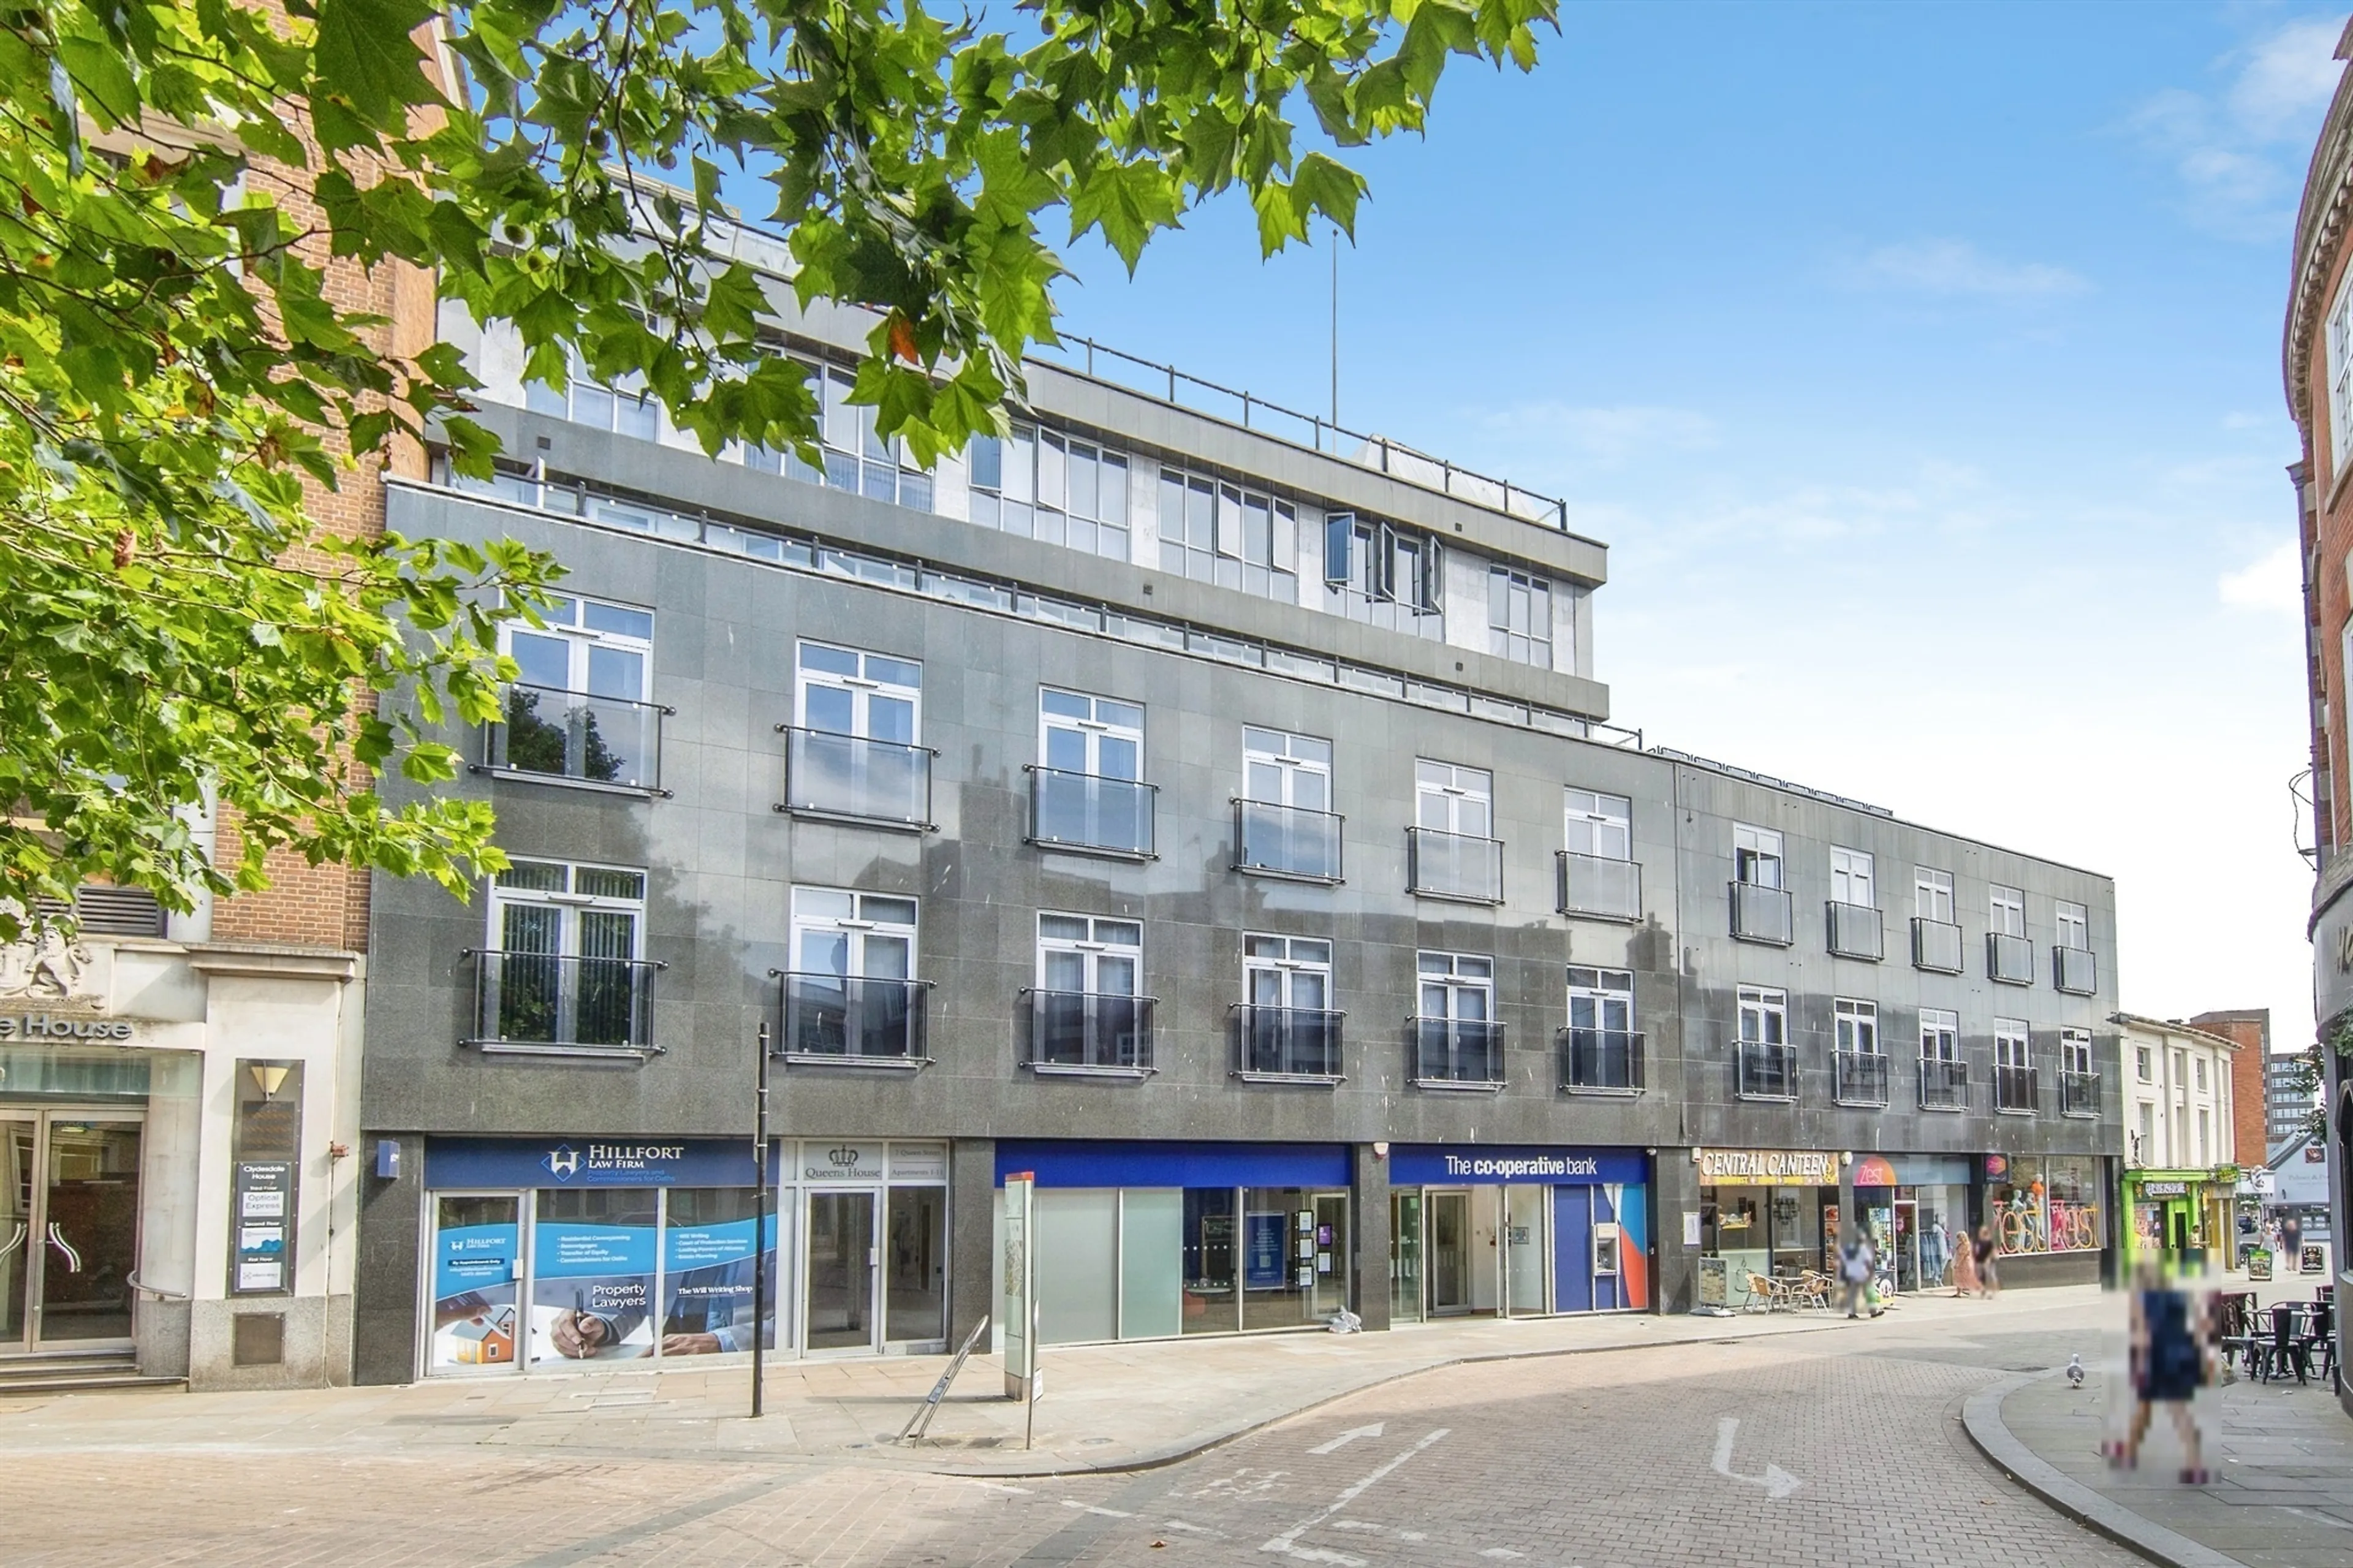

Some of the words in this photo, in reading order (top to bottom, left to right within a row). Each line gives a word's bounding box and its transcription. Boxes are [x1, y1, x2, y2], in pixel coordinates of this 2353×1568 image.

[24, 1013, 132, 1039] House
[589, 1145, 684, 1159] HILLFORT
[588, 1159, 613, 1168] LAW
[616, 1159, 644, 1168] FIRM
[1445, 1156, 1471, 1175] The
[1474, 1156, 1564, 1179] co-operative
[1567, 1157, 1597, 1175] bank
[1702, 1153, 1765, 1176] CENTRAL
[1767, 1154, 1828, 1176] CANTEEN
[805, 1167, 845, 1178] Queens
[848, 1167, 881, 1178] House
[1860, 1165, 1884, 1184] Zest
[593, 1284, 646, 1298] Property
[734, 1286, 753, 1294] Shop
[593, 1296, 646, 1309] Lawyers
